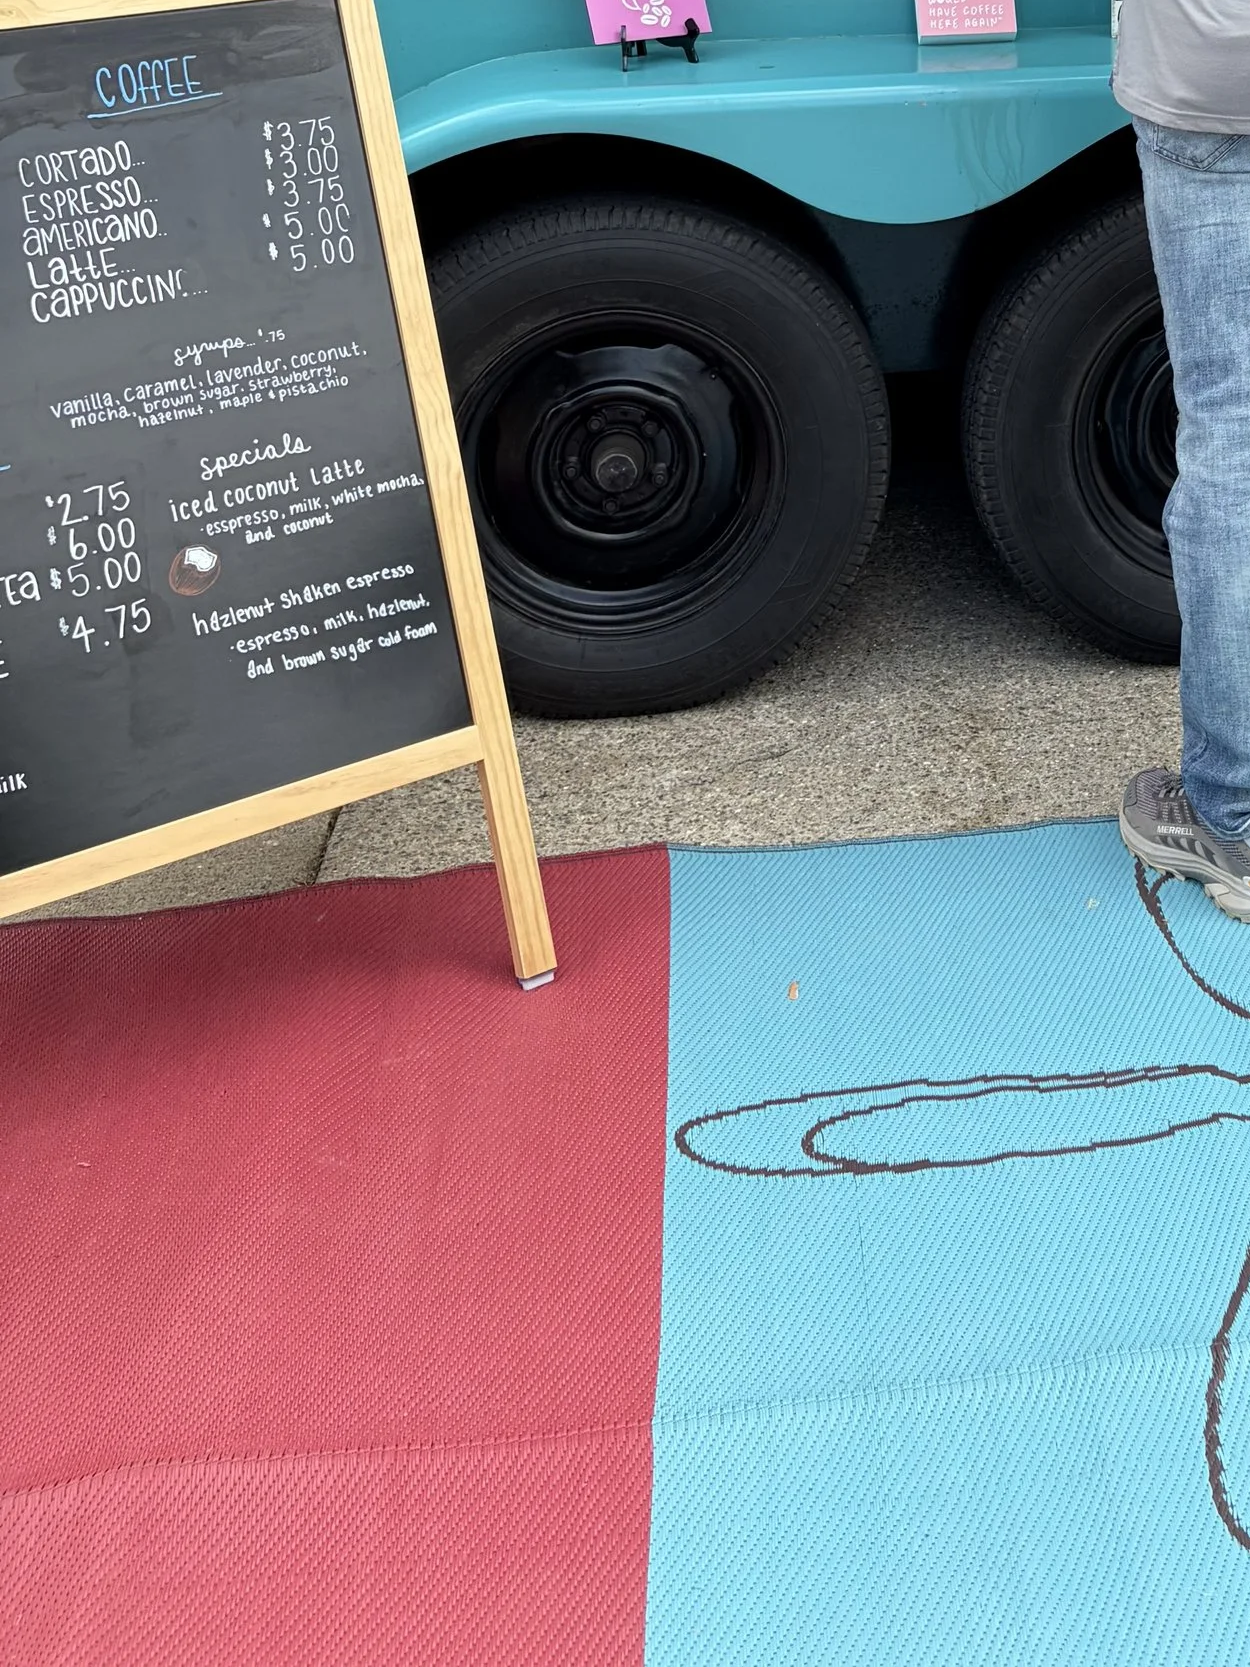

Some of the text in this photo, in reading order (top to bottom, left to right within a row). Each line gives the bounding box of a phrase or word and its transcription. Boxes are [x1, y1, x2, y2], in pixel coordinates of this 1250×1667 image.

[929, 4, 1004, 17] HAVE COFFEE
[930, 18, 959, 29] HERE
[50, 341, 368, 419] vanilla, caramel, lavender, coconut,
[71, 403, 137, 429] mocha,
[144, 393, 194, 415] brown
[248, 365, 337, 392] strawberry,
[219, 392, 263, 410] maple
[278, 375, 349, 402] pistachio
[168, 489, 218, 522] iced
[223, 471, 300, 508] coconut
[332, 481, 374, 507] white
[377, 472, 425, 494] mocha,
[245, 511, 334, 545] and coconut
[192, 597, 275, 636] hazlenut
[345, 563, 415, 591] espresso
[236, 624, 318, 654] espresso,
[246, 620, 438, 680] and brown sugar cold foam
[1157, 824, 1194, 836] MERRELL
